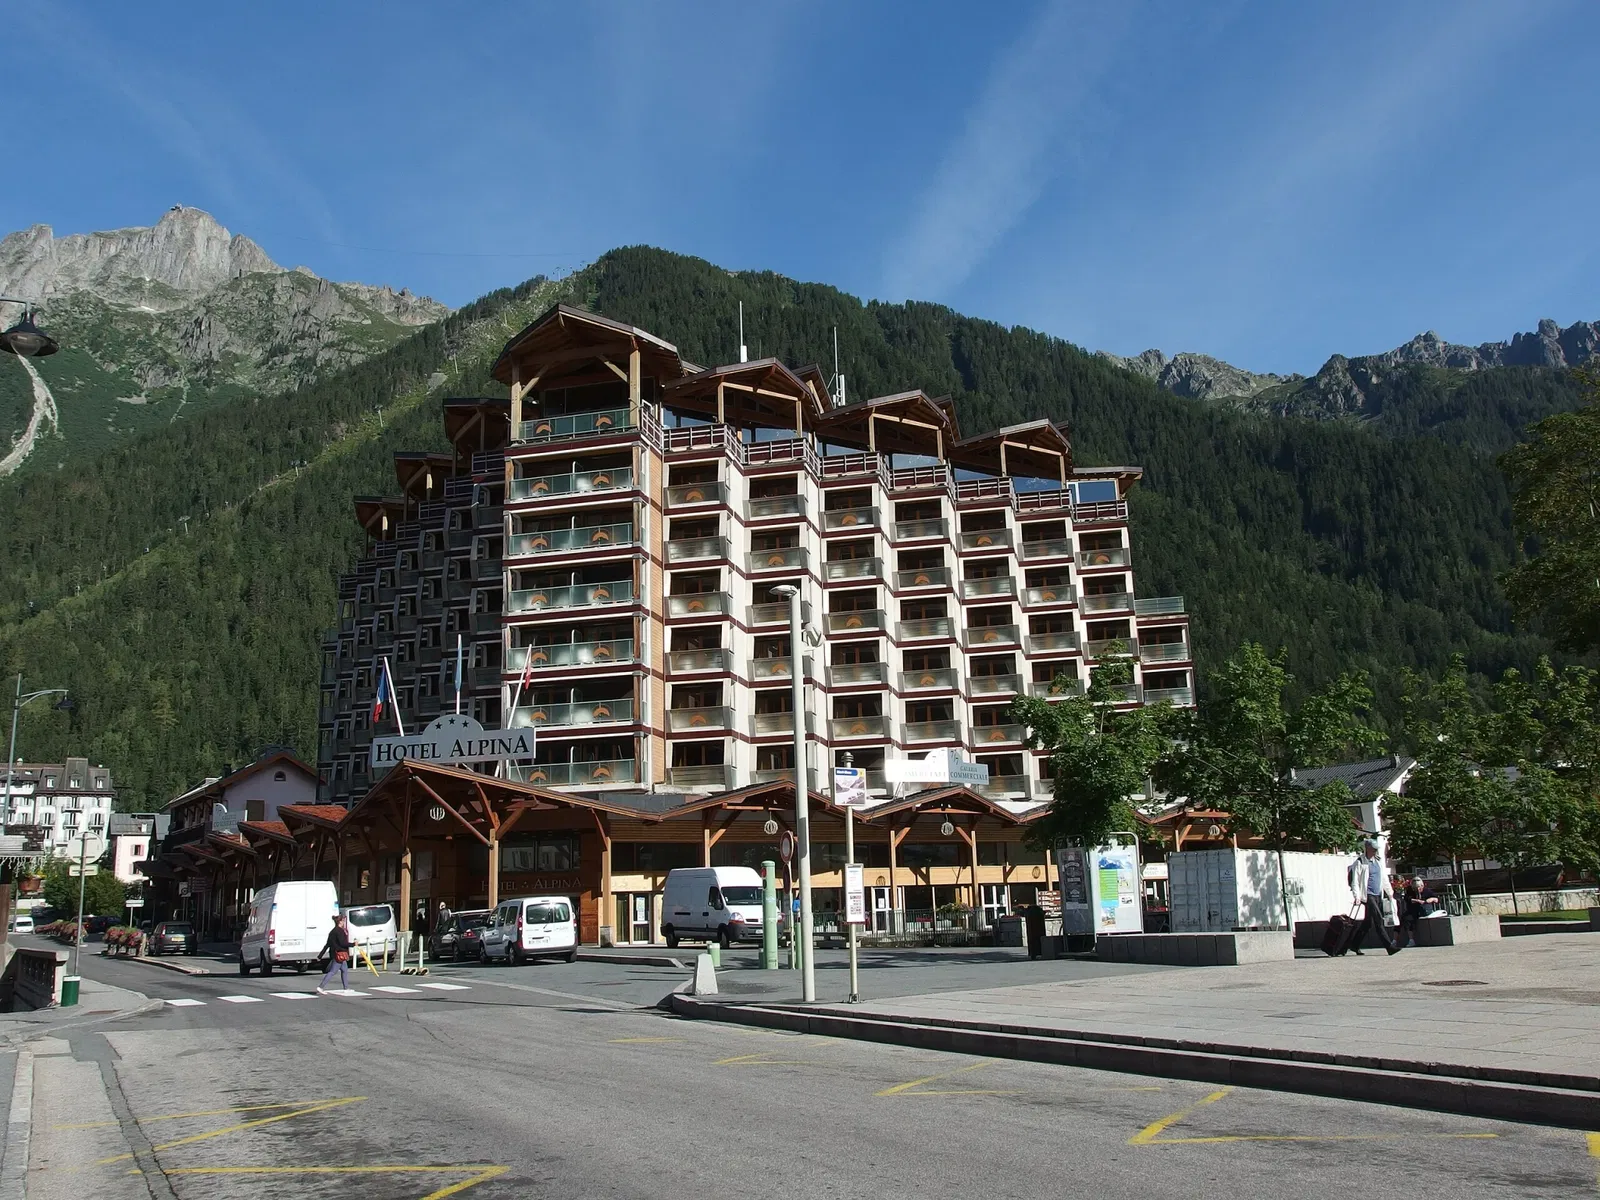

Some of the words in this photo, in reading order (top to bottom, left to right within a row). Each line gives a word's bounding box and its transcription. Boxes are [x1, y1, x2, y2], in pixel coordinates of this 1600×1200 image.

[376, 742, 442, 762] HOTEL
[450, 734, 530, 757] ALPINA
[481, 880, 518, 891] HTEL
[533, 877, 582, 889] ALPINA
